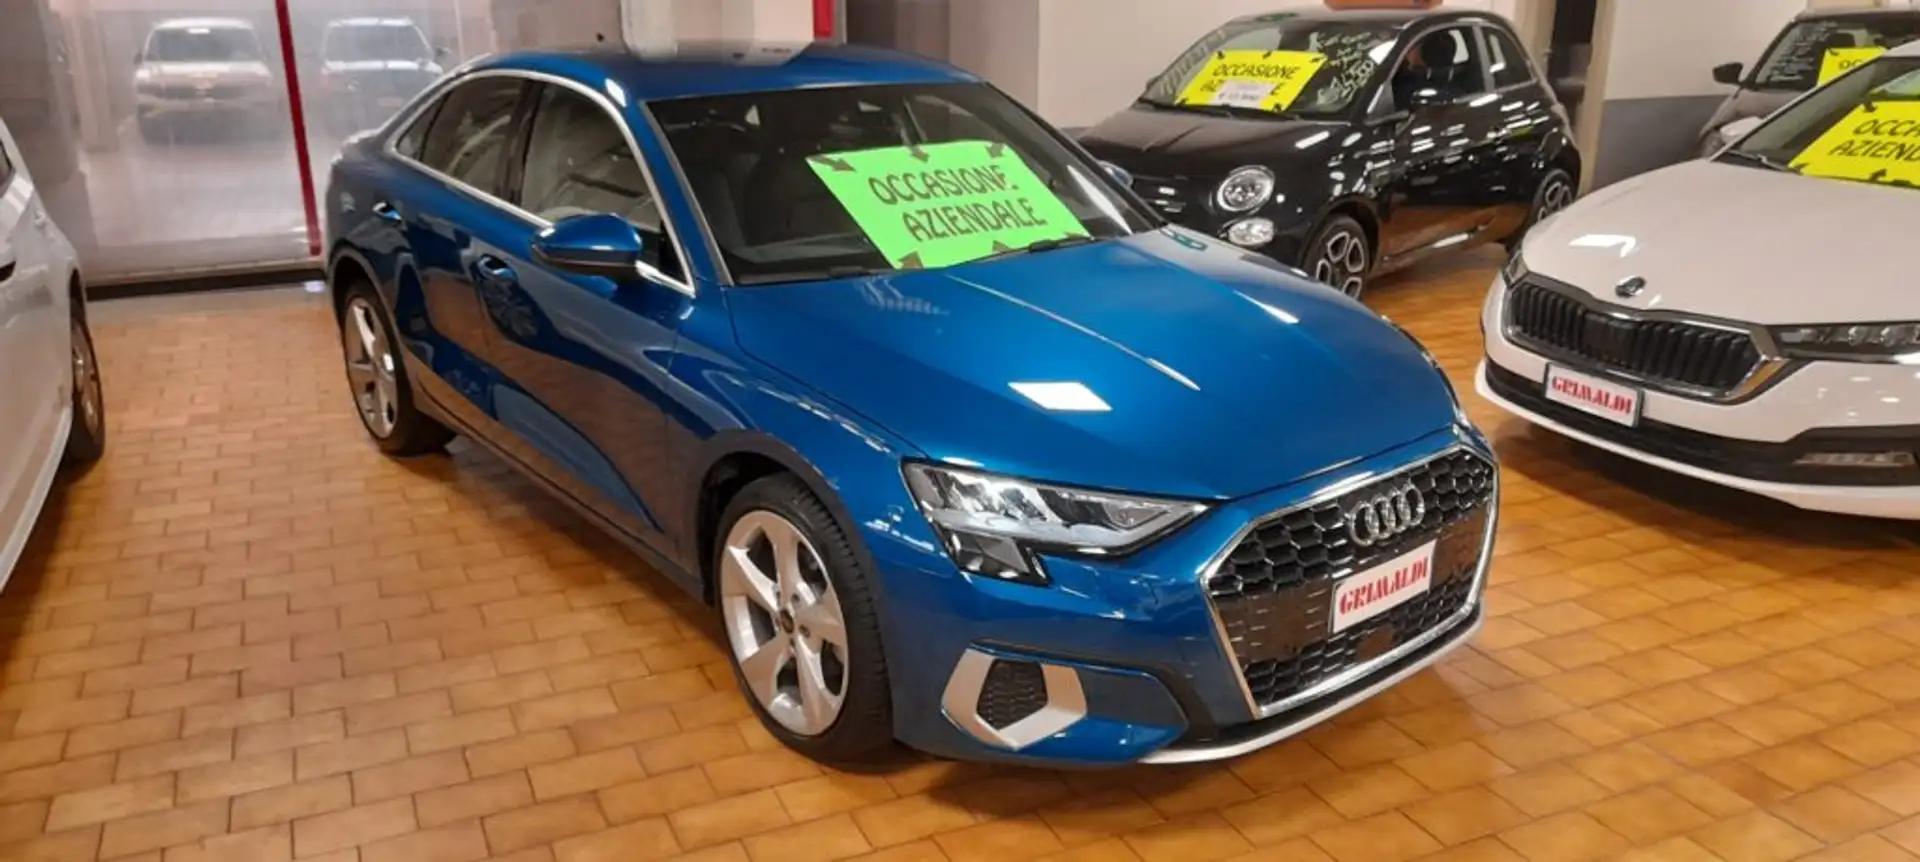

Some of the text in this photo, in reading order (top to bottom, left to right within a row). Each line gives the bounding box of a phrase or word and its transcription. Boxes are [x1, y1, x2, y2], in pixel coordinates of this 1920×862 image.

[1213, 64, 1300, 78] OCCASIONE
[867, 165, 1012, 205] OCCASIONE
[902, 198, 1047, 242] AZIENDALE
[1552, 376, 1632, 415] GRIMALDI
[1339, 556, 1428, 615] GRIMALDI
